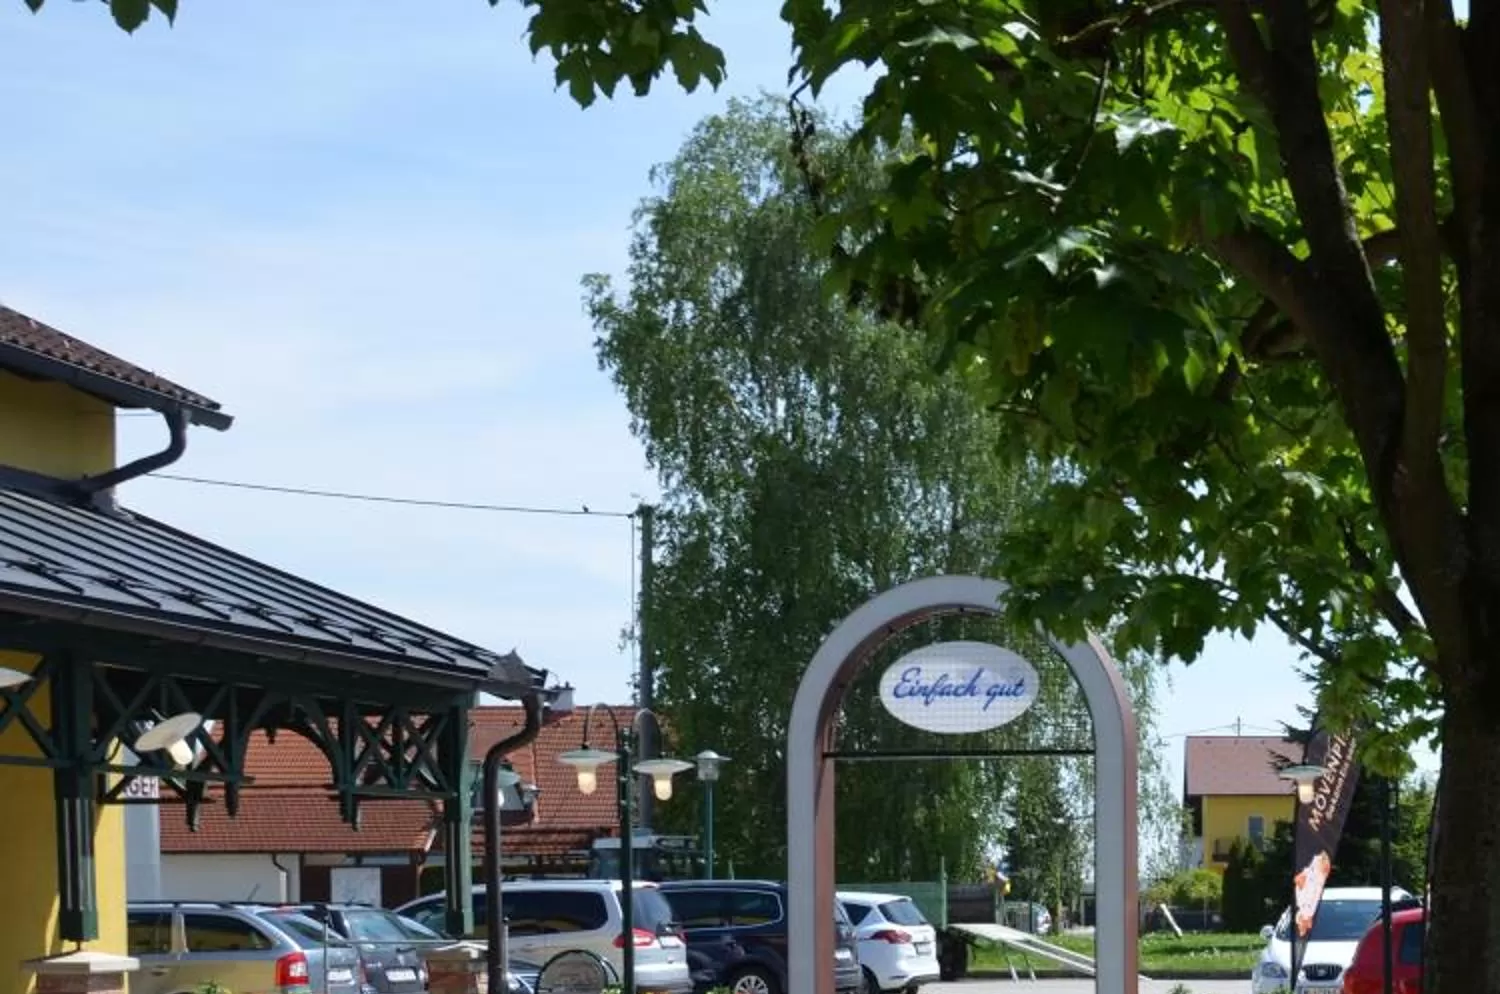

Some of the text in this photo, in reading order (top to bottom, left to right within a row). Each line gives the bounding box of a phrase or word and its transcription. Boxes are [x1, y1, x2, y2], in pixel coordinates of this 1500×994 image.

[893, 667, 1025, 711] Einfach gut
[1308, 728, 1351, 832] MÖVENPI
